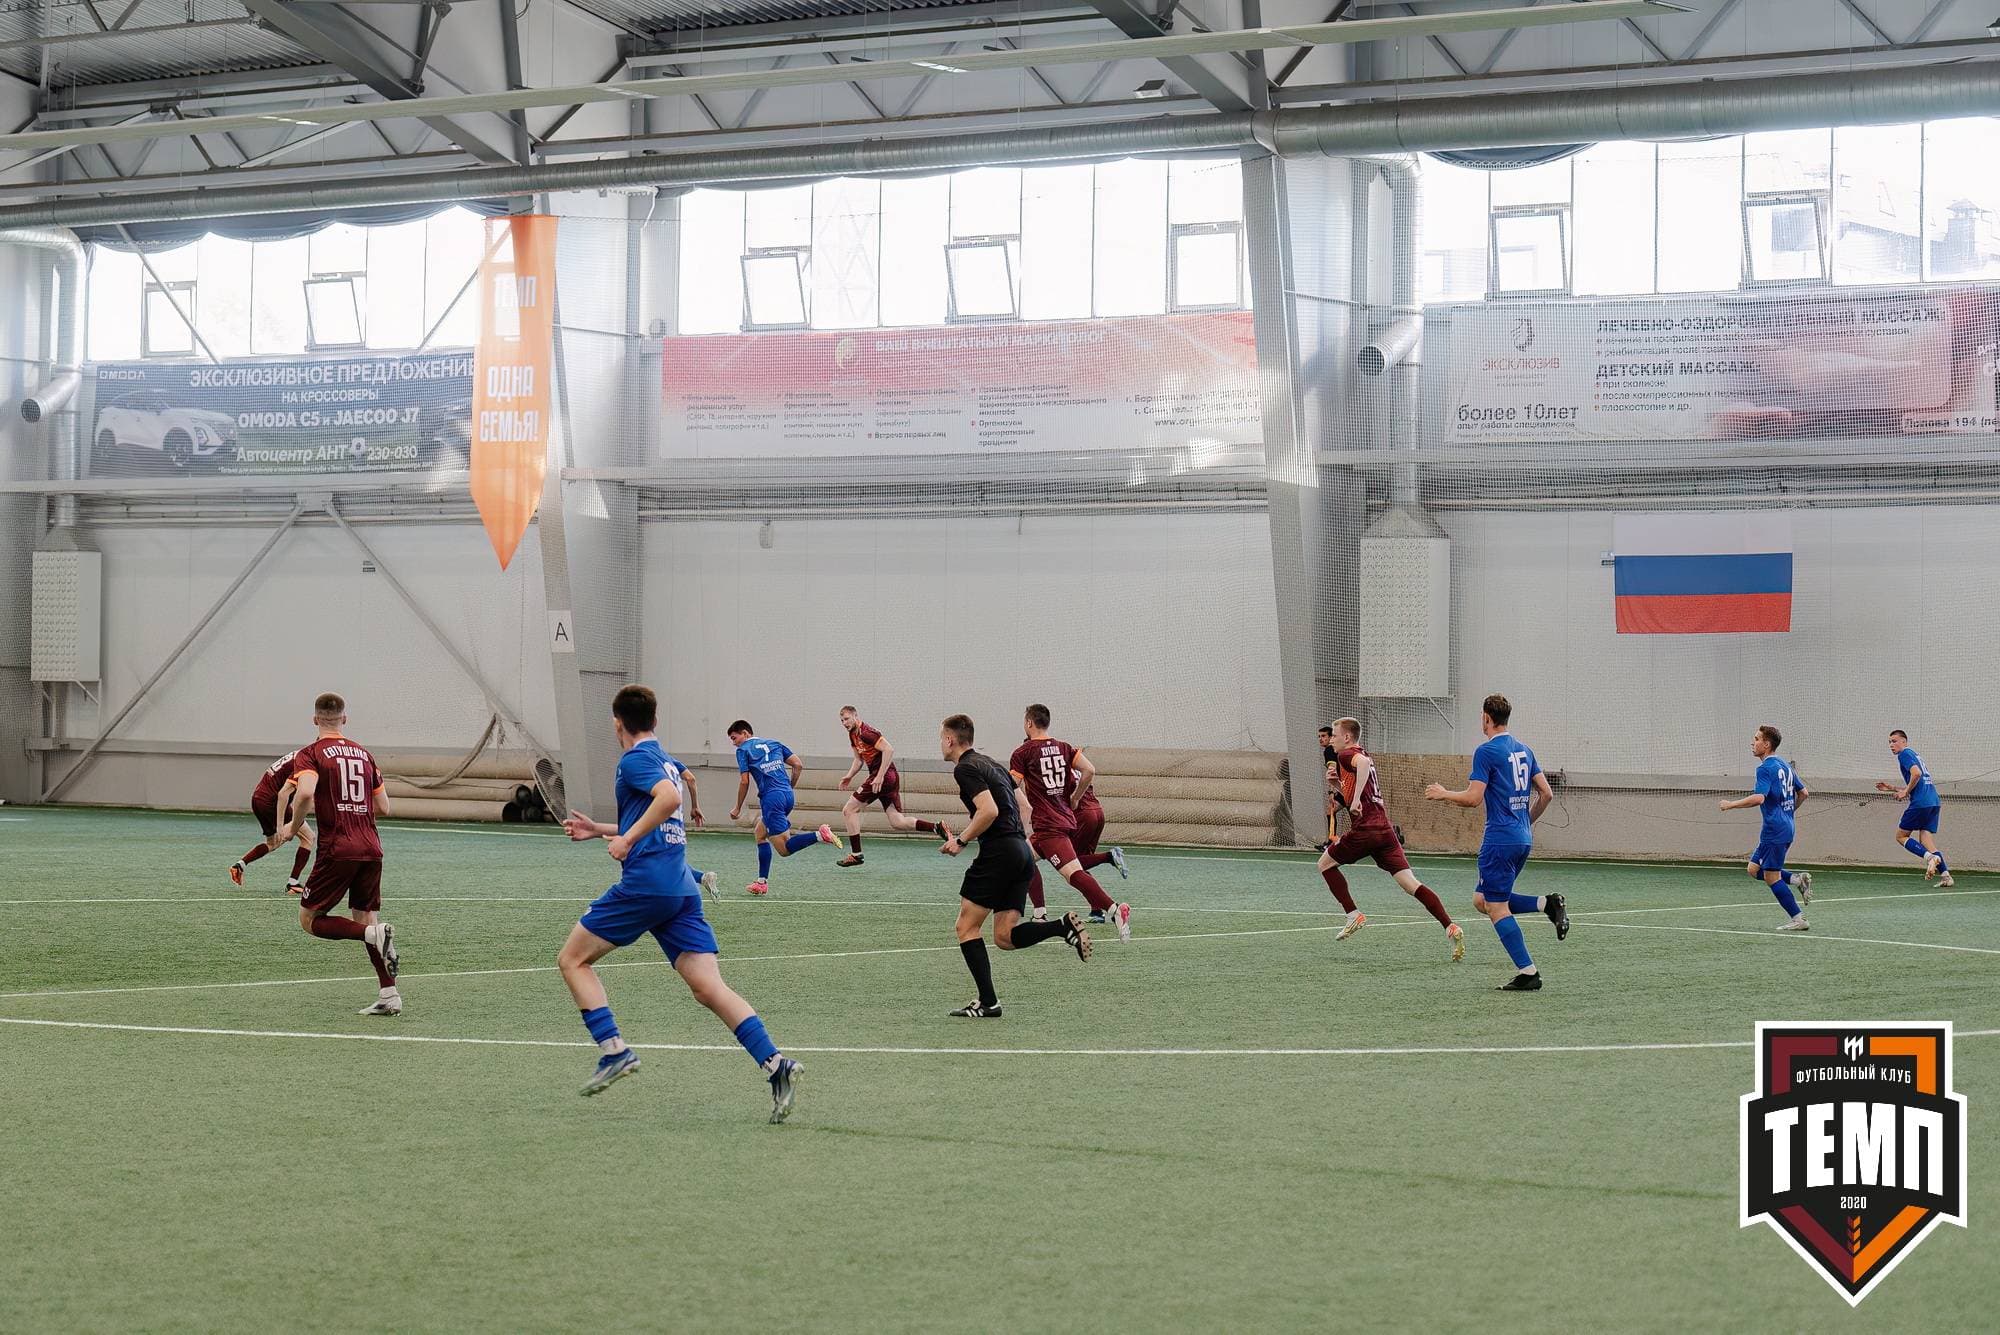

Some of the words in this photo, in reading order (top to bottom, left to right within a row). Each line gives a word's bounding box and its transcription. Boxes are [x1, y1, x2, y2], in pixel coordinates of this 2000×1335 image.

[190, 365, 335, 387] ЭКСКЛЮЗИВНОЕ
[337, 358, 475, 385] ПРЕДЛОЖЕНИЕ
[1482, 356, 1560, 372] ЭКСКЛЮЗИВ
[1596, 359, 1674, 380] ДЕТСКИЙ
[99, 370, 146, 380] OMODA
[487, 365, 534, 402] ОДНА
[1602, 381, 1620, 389] при
[282, 391, 298, 403] НА
[300, 388, 380, 402] КРОССОВЕРЫ
[1602, 392, 1630, 400] после
[1458, 403, 1517, 421] более
[1523, 402, 1579, 420] 10лет
[1601, 403, 1667, 412] плоскостопие
[1669, 402, 1675, 411] и
[1676, 402, 1692, 413] др.
[238, 411, 297, 428] OMODA
[300, 410, 320, 426] C5
[322, 416, 331, 426] и
[333, 408, 398, 426] JAECOO
[401, 407, 420, 423] J7
[480, 410, 539, 442] СЕМЬЯ!
[1457, 422, 1479, 431] опыт
[1481, 420, 1513, 430] работы
[236, 446, 313, 464] Автоцентр
[316, 444, 349, 460] АНТ
[367, 445, 418, 460] 230-030
[755, 744, 770, 762] 7
[336, 757, 365, 803] 15
[1040, 755, 1066, 789] 55
[1508, 751, 1529, 791] 15
[1778, 768, 1794, 799] 34
[336, 803, 368, 813] SEUS
